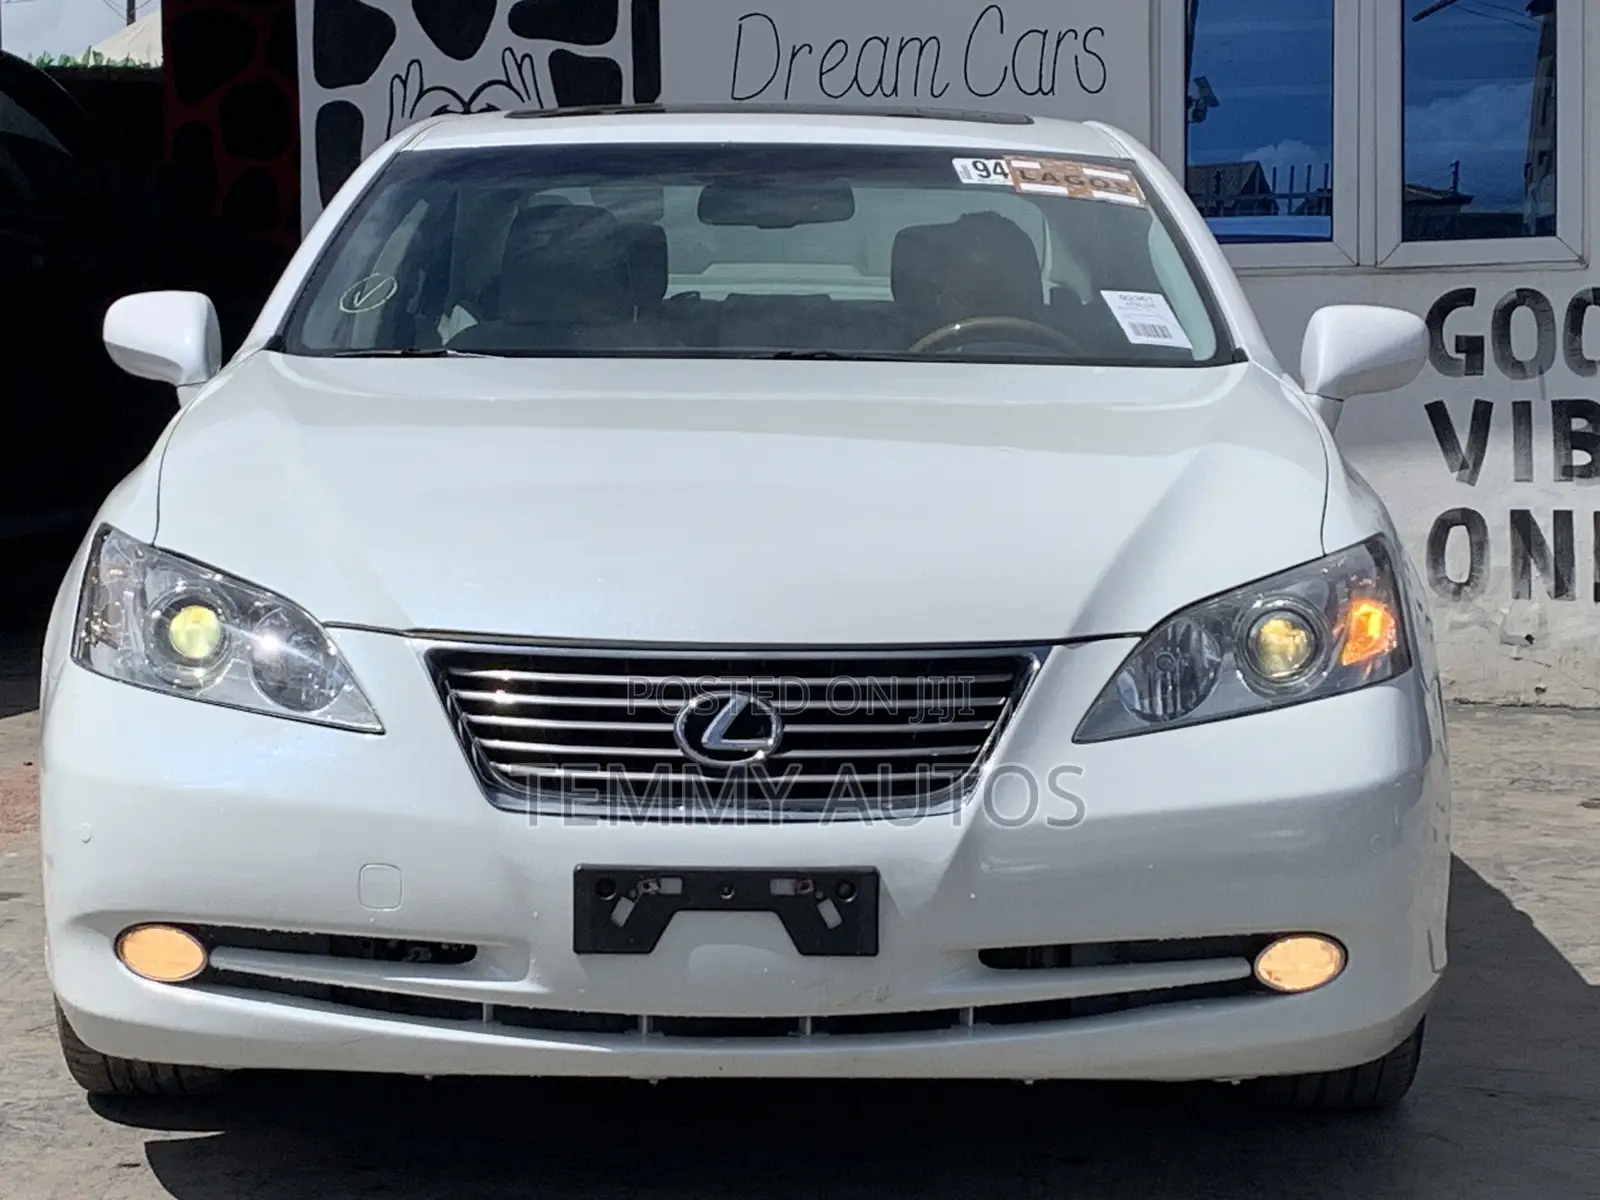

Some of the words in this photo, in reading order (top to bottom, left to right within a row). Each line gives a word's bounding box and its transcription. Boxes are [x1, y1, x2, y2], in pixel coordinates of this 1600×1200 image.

[731, 12, 950, 101] Dream
[964, 4, 1107, 97] Cars
[971, 159, 1009, 180] 94
[1426, 507, 1600, 602] ON
